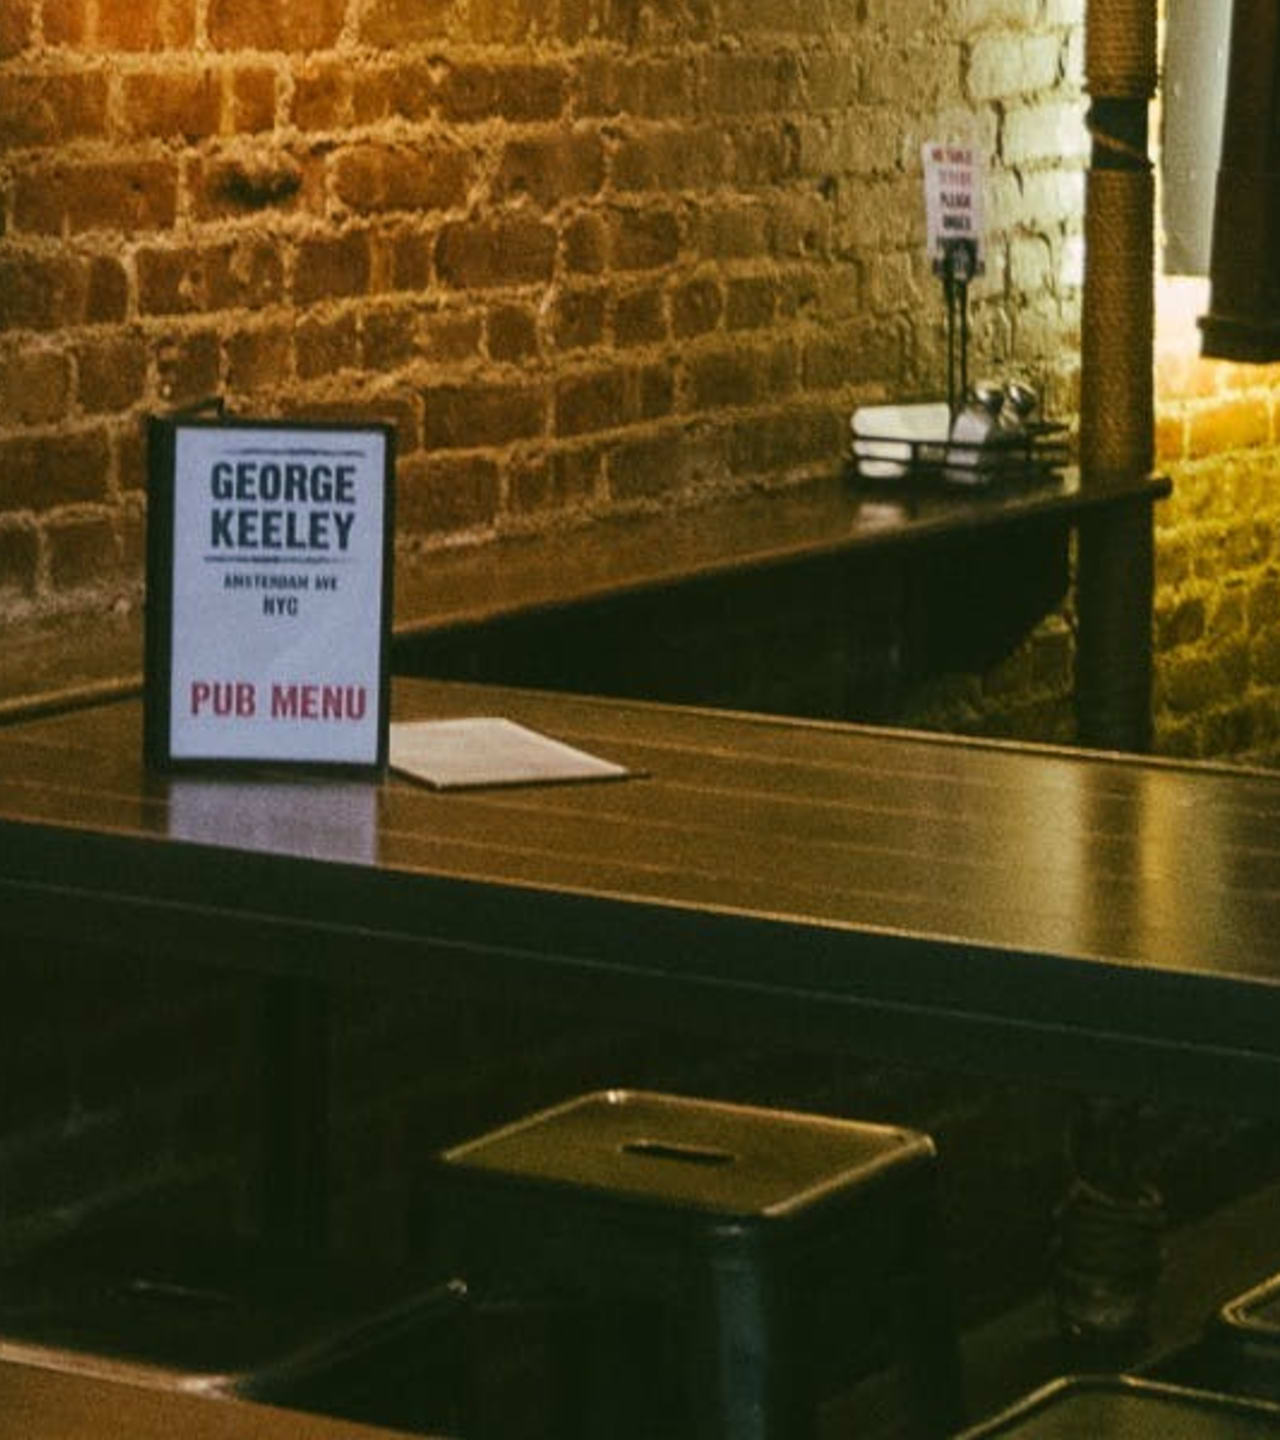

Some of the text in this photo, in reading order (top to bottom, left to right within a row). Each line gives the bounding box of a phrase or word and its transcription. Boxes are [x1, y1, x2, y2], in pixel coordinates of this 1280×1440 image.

[211, 462, 357, 504] GEORGE
[211, 510, 356, 551] KEELEY
[223, 574, 338, 592] AMSTERDAM AVE
[263, 596, 299, 616] NYC
[190, 681, 367, 721] PUB MENU
